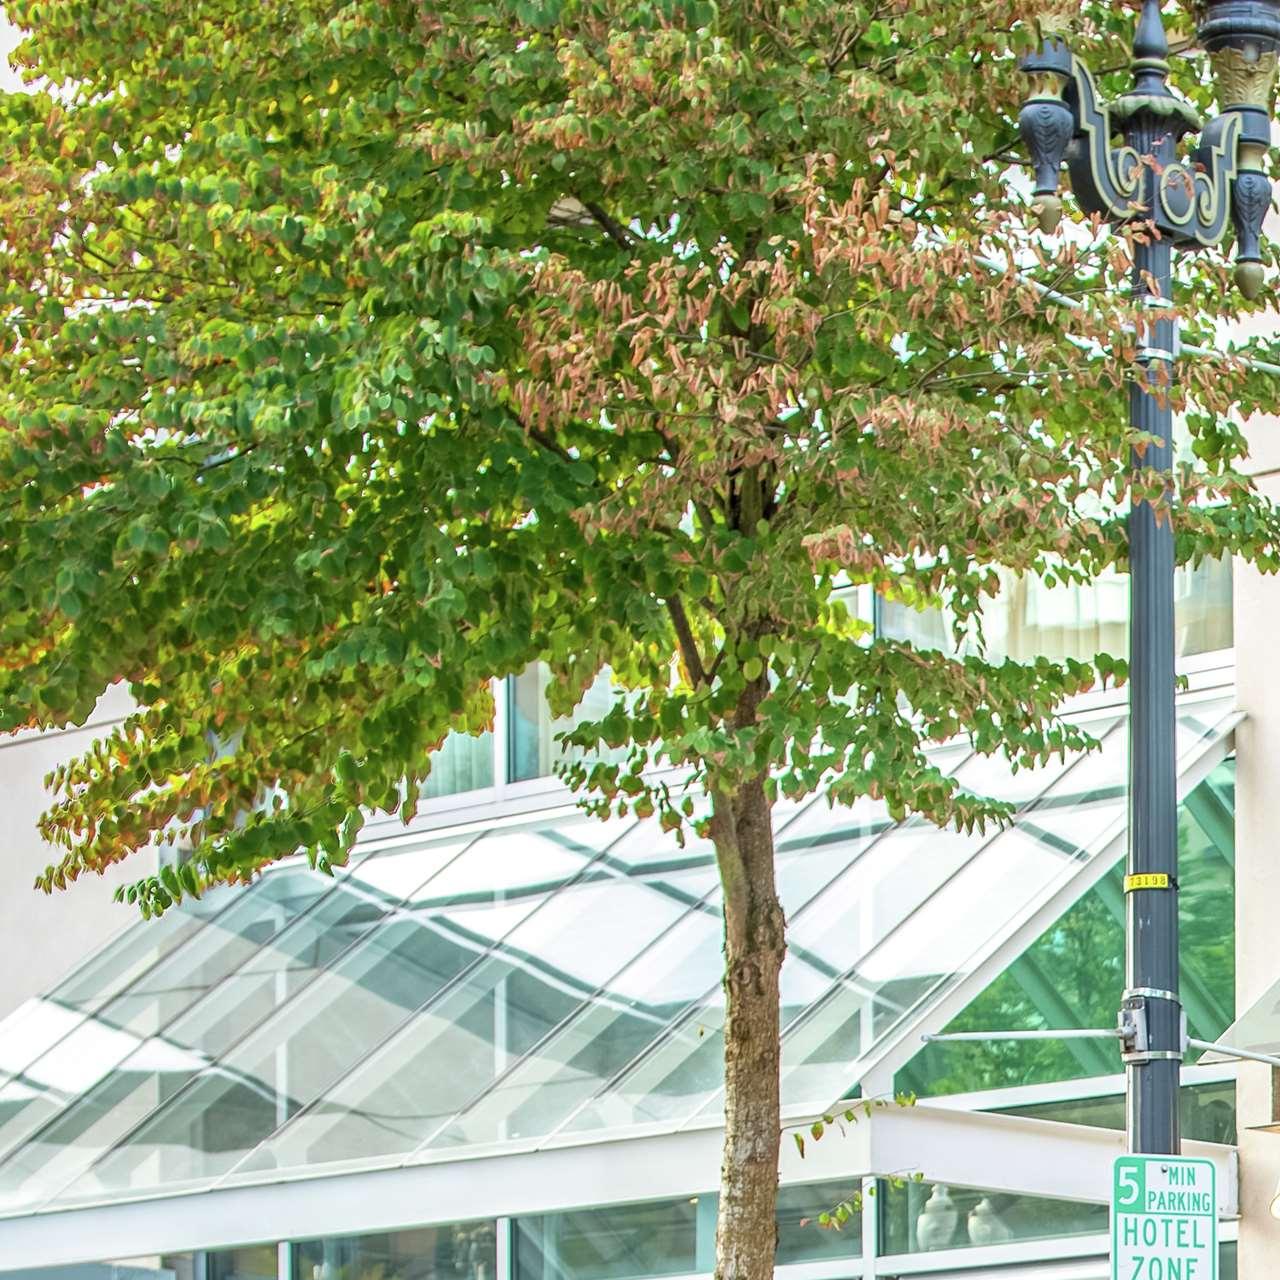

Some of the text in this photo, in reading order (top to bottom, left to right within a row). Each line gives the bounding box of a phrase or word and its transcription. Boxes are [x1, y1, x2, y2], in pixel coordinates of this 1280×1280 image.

[1118, 1166, 1139, 1205] 5
[1168, 1166, 1196, 1186] MIN
[1148, 1191, 1210, 1211] PARKING
[1124, 1217, 1205, 1249] HOTEL
